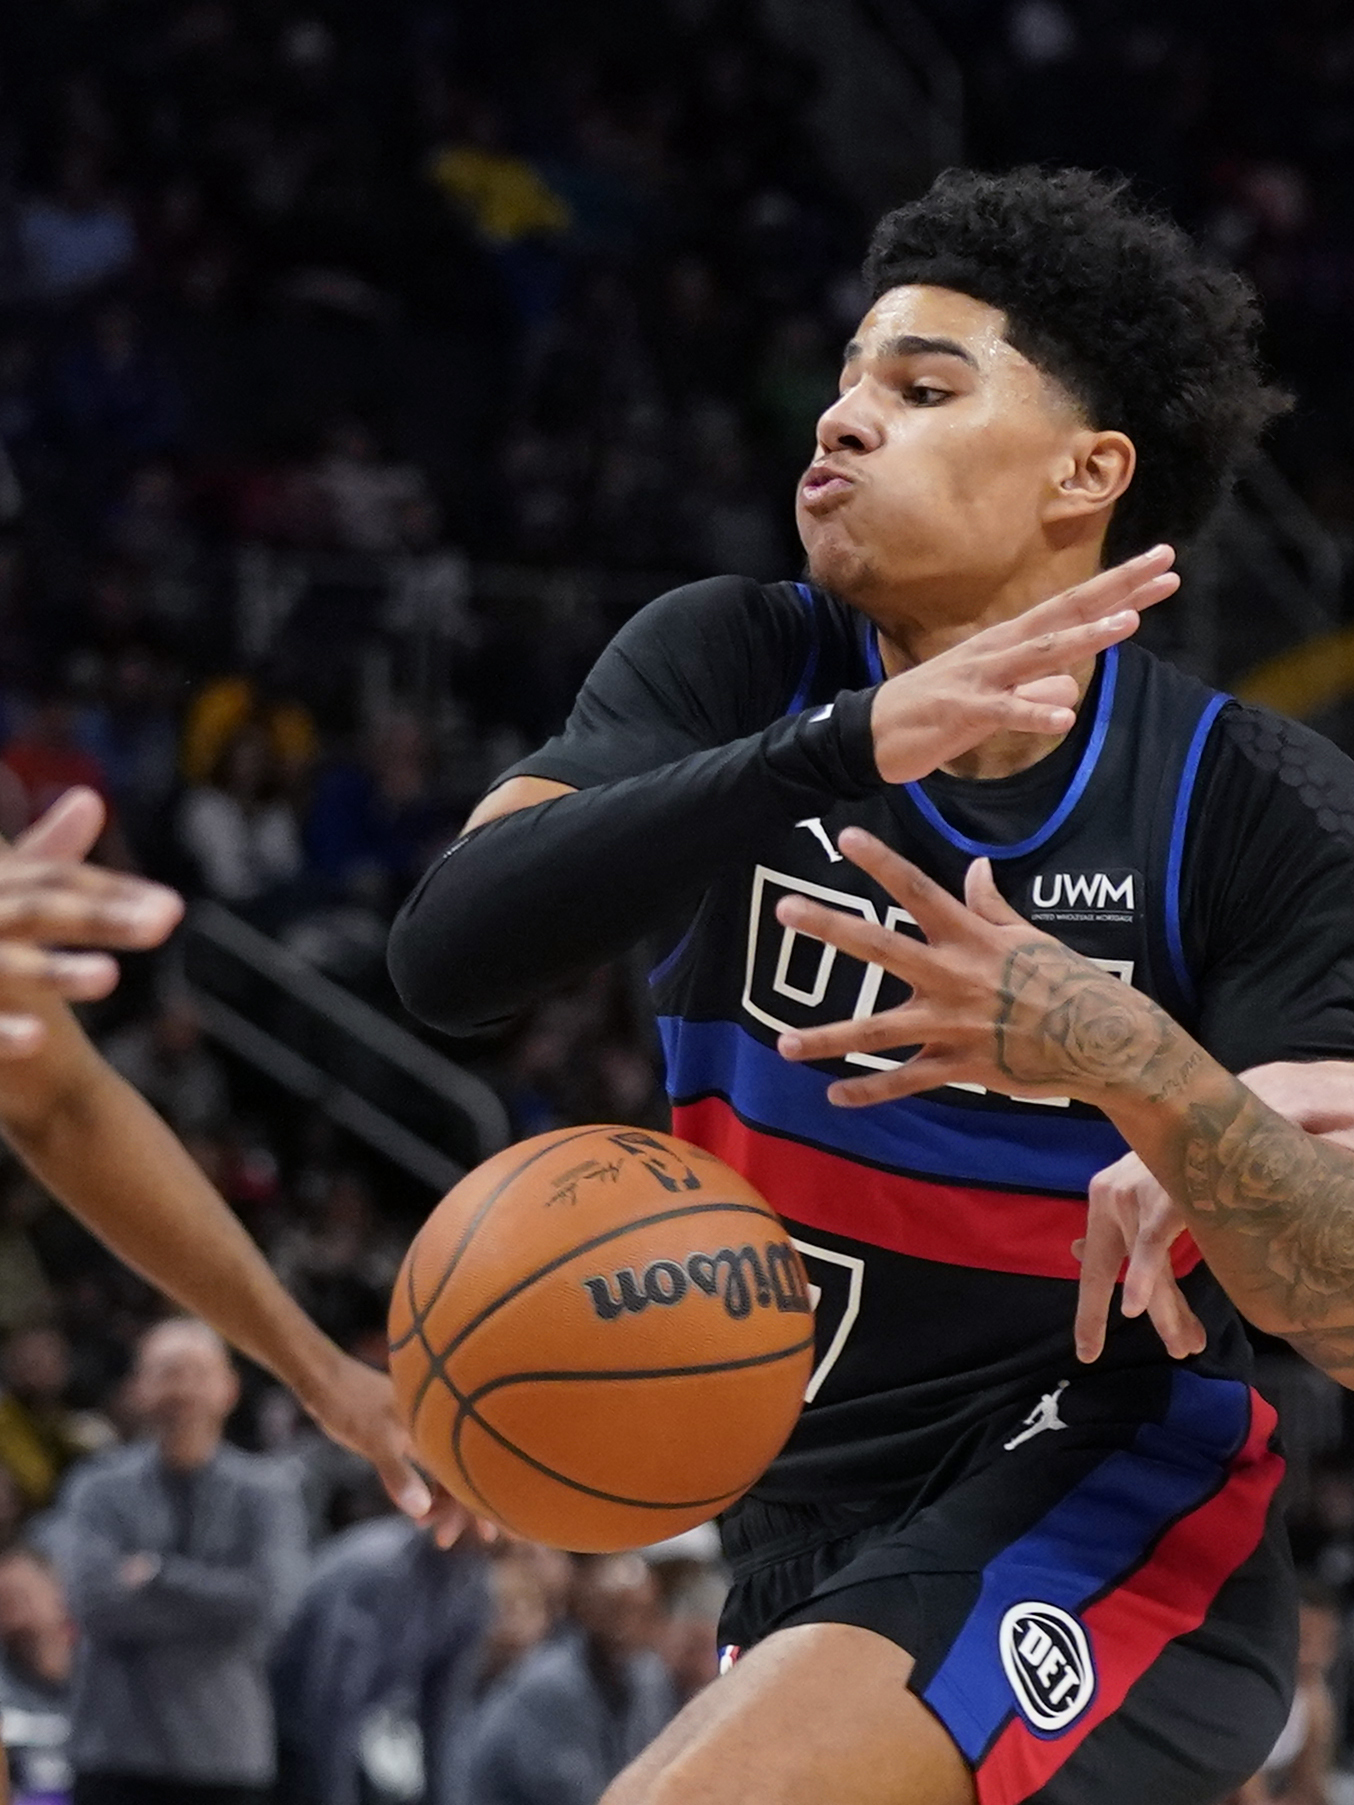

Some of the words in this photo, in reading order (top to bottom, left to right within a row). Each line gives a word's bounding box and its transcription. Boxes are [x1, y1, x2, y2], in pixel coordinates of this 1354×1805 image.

[1032, 873, 1135, 910] UWM
[582, 1240, 812, 1321] Wilson
[1018, 1620, 1081, 1705] DET
